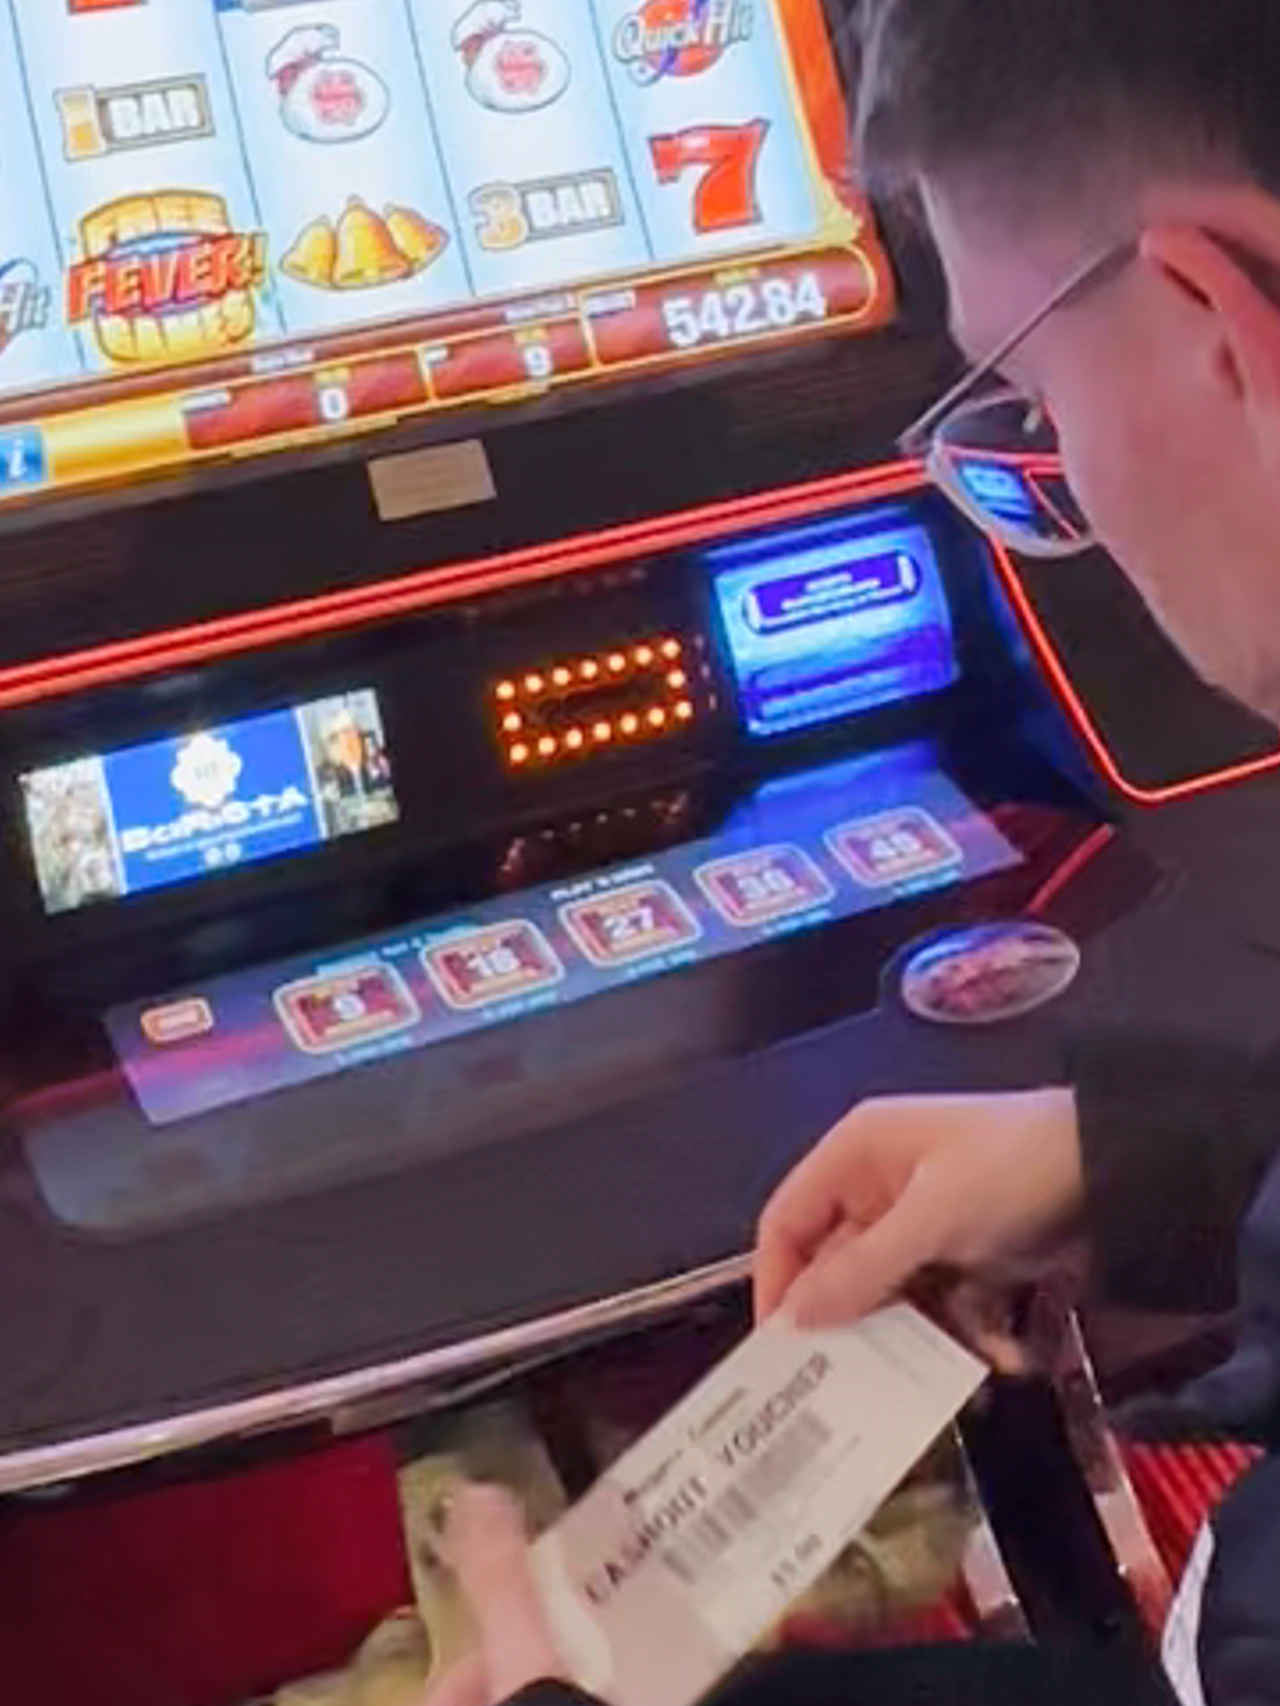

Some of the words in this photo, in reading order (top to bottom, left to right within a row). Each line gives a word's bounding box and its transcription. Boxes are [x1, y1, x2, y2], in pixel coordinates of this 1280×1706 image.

[104, 82, 205, 145] BAR
[526, 180, 613, 234] BAR
[647, 118, 772, 236] 7
[714, 1352, 834, 1467] VOUCHER
